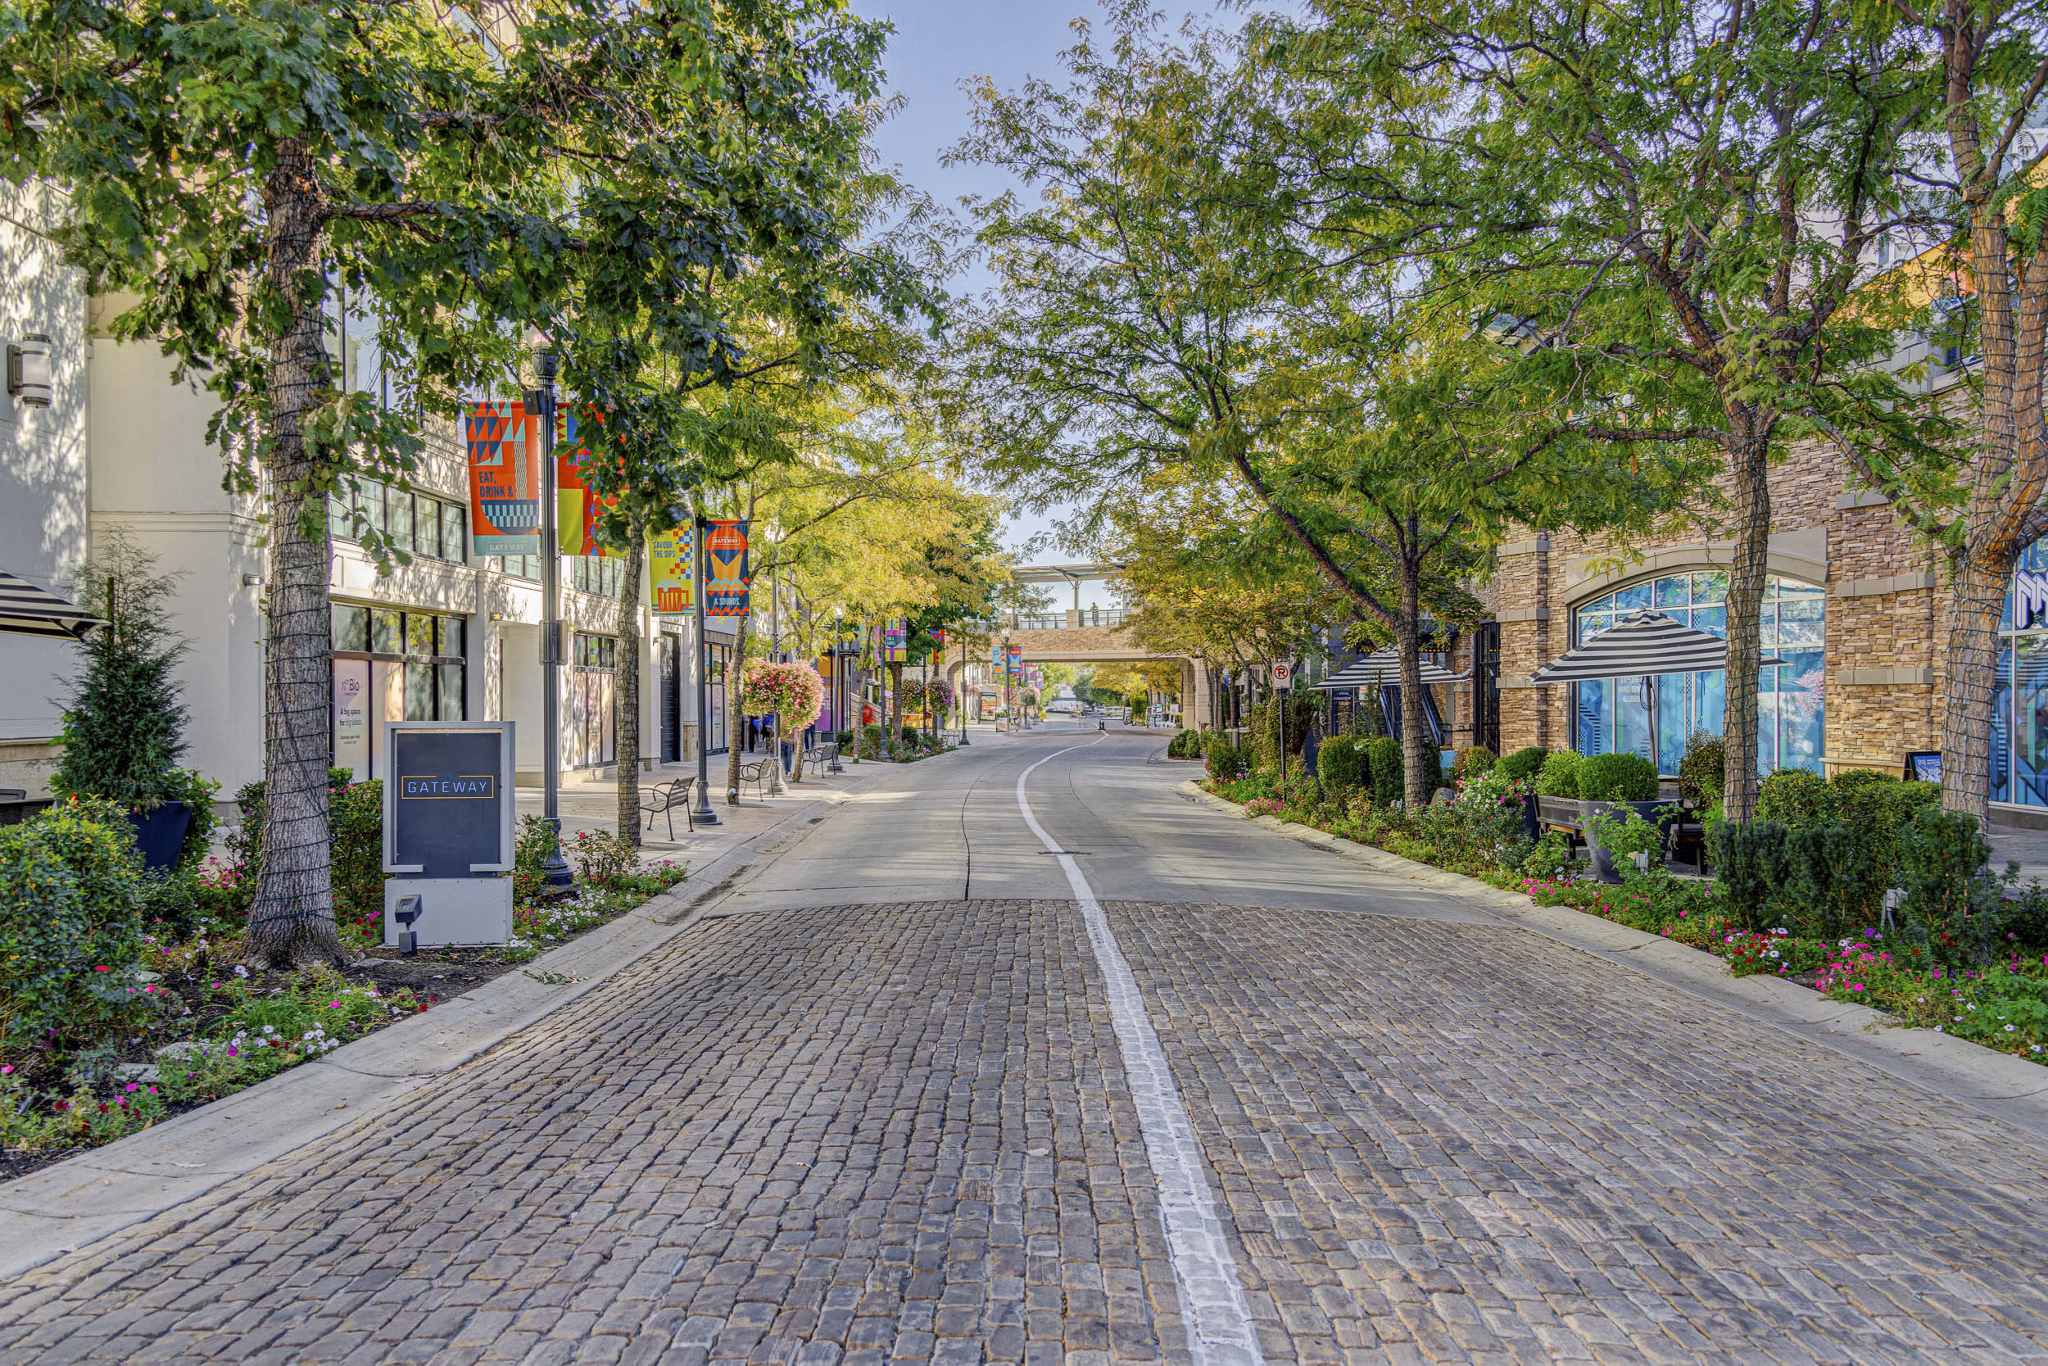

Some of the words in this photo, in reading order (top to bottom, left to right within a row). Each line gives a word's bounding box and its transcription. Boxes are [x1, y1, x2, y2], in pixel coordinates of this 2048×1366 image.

[478, 472, 496, 484] EAT,
[479, 486, 506, 498] DRINK
[507, 486, 514, 497] &
[653, 550, 663, 558] THE
[664, 550, 676, 558] SIPS
[408, 781, 487, 793] GATEWAY
